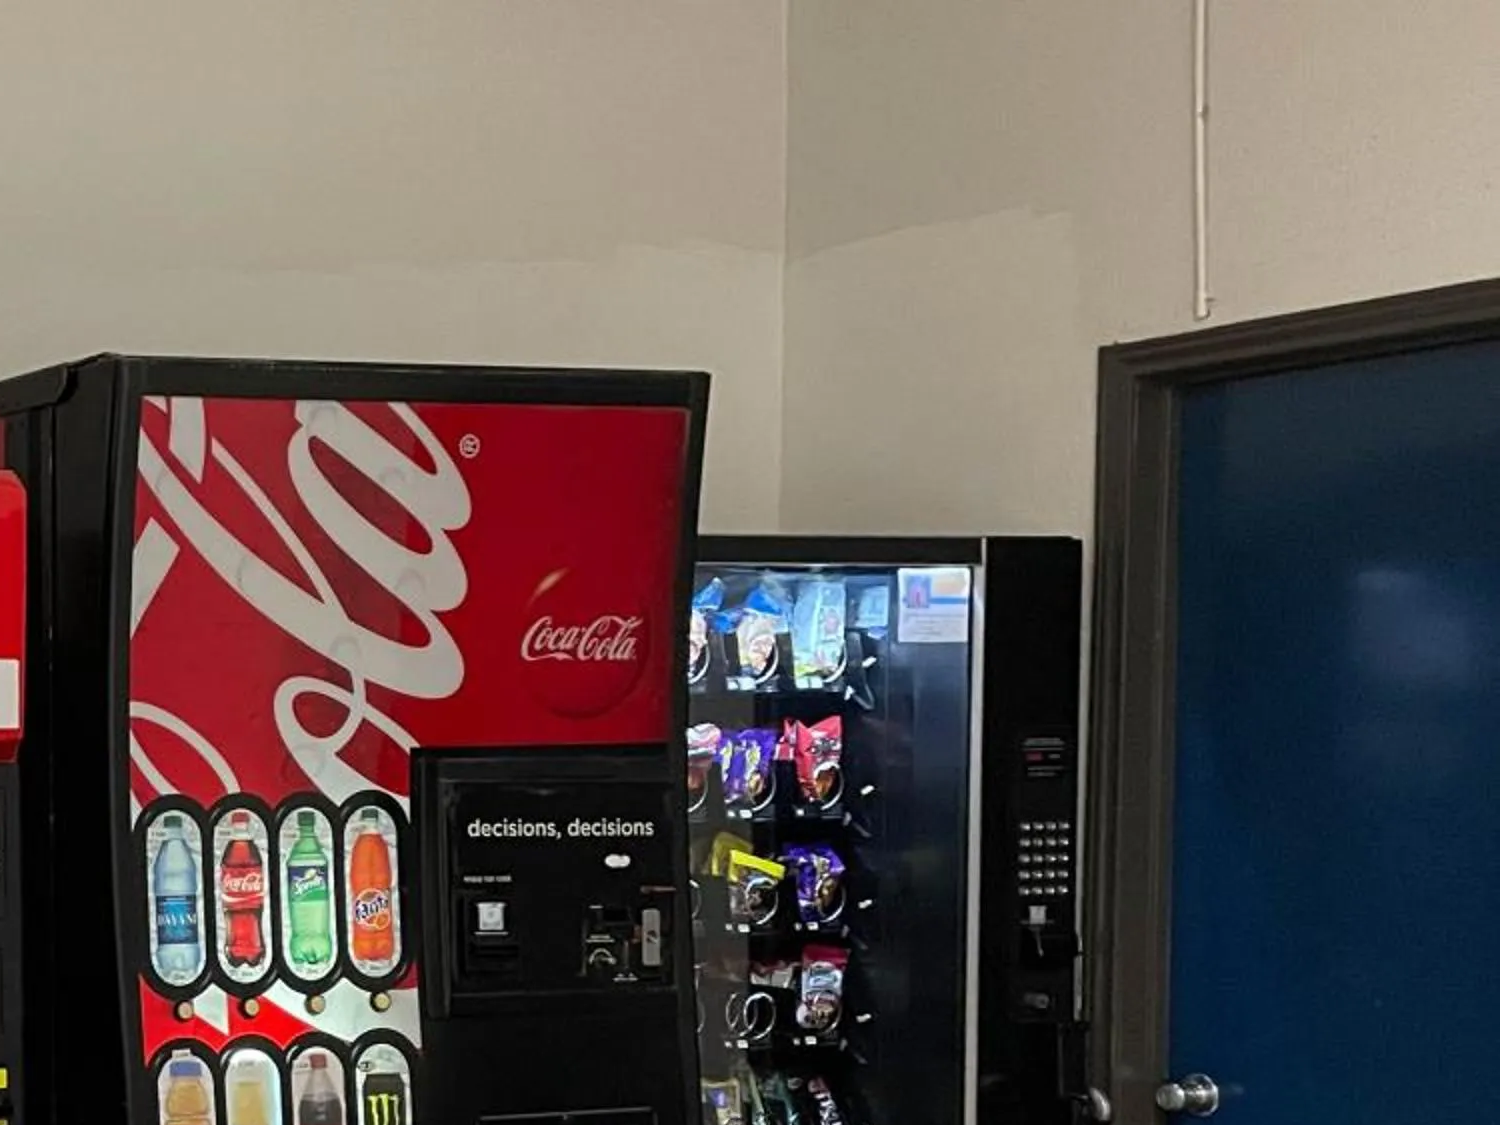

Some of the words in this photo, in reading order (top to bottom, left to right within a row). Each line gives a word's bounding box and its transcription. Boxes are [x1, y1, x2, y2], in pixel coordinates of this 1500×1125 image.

[521, 614, 644, 662] Coca-Cola
[467, 818, 563, 840] decisions,
[567, 818, 655, 837] decisions
